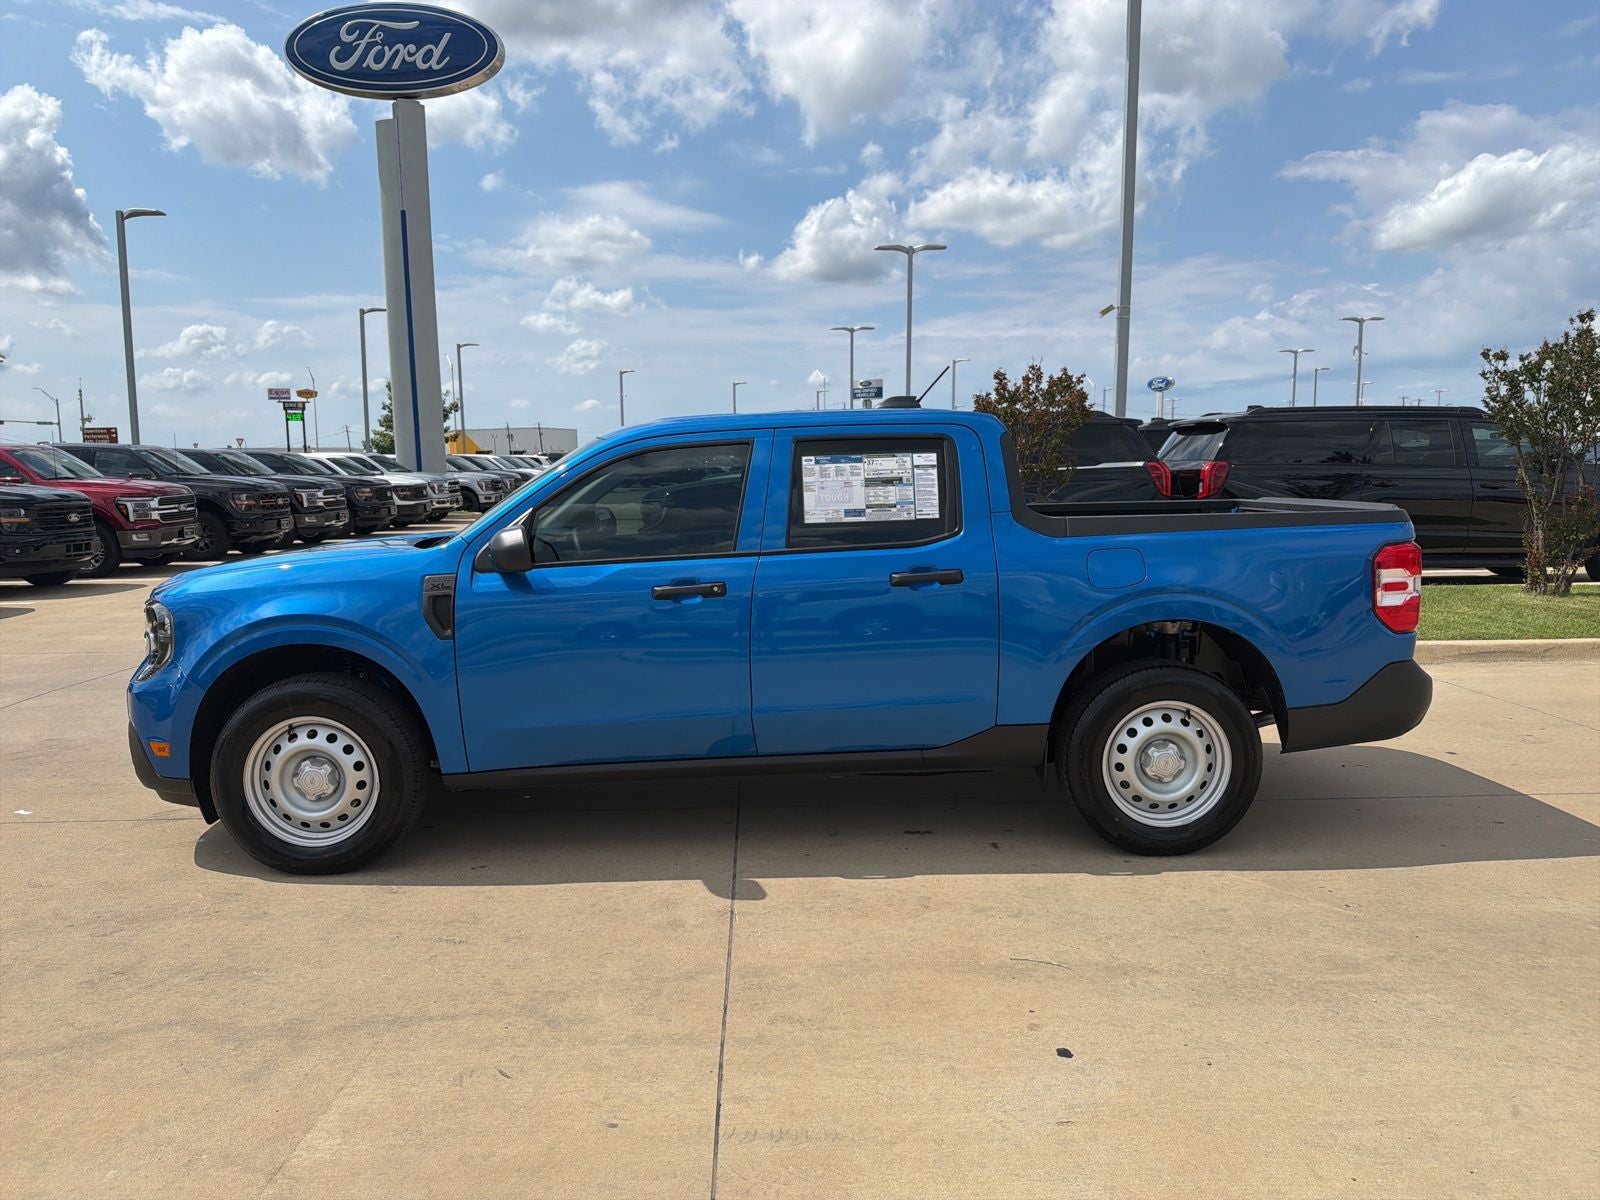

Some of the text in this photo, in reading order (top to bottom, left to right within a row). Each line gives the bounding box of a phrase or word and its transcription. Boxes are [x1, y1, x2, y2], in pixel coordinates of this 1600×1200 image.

[329, 19, 452, 71] Ford
[1151, 379, 1167, 388] Ford
[820, 493, 849, 502] TOUGH
